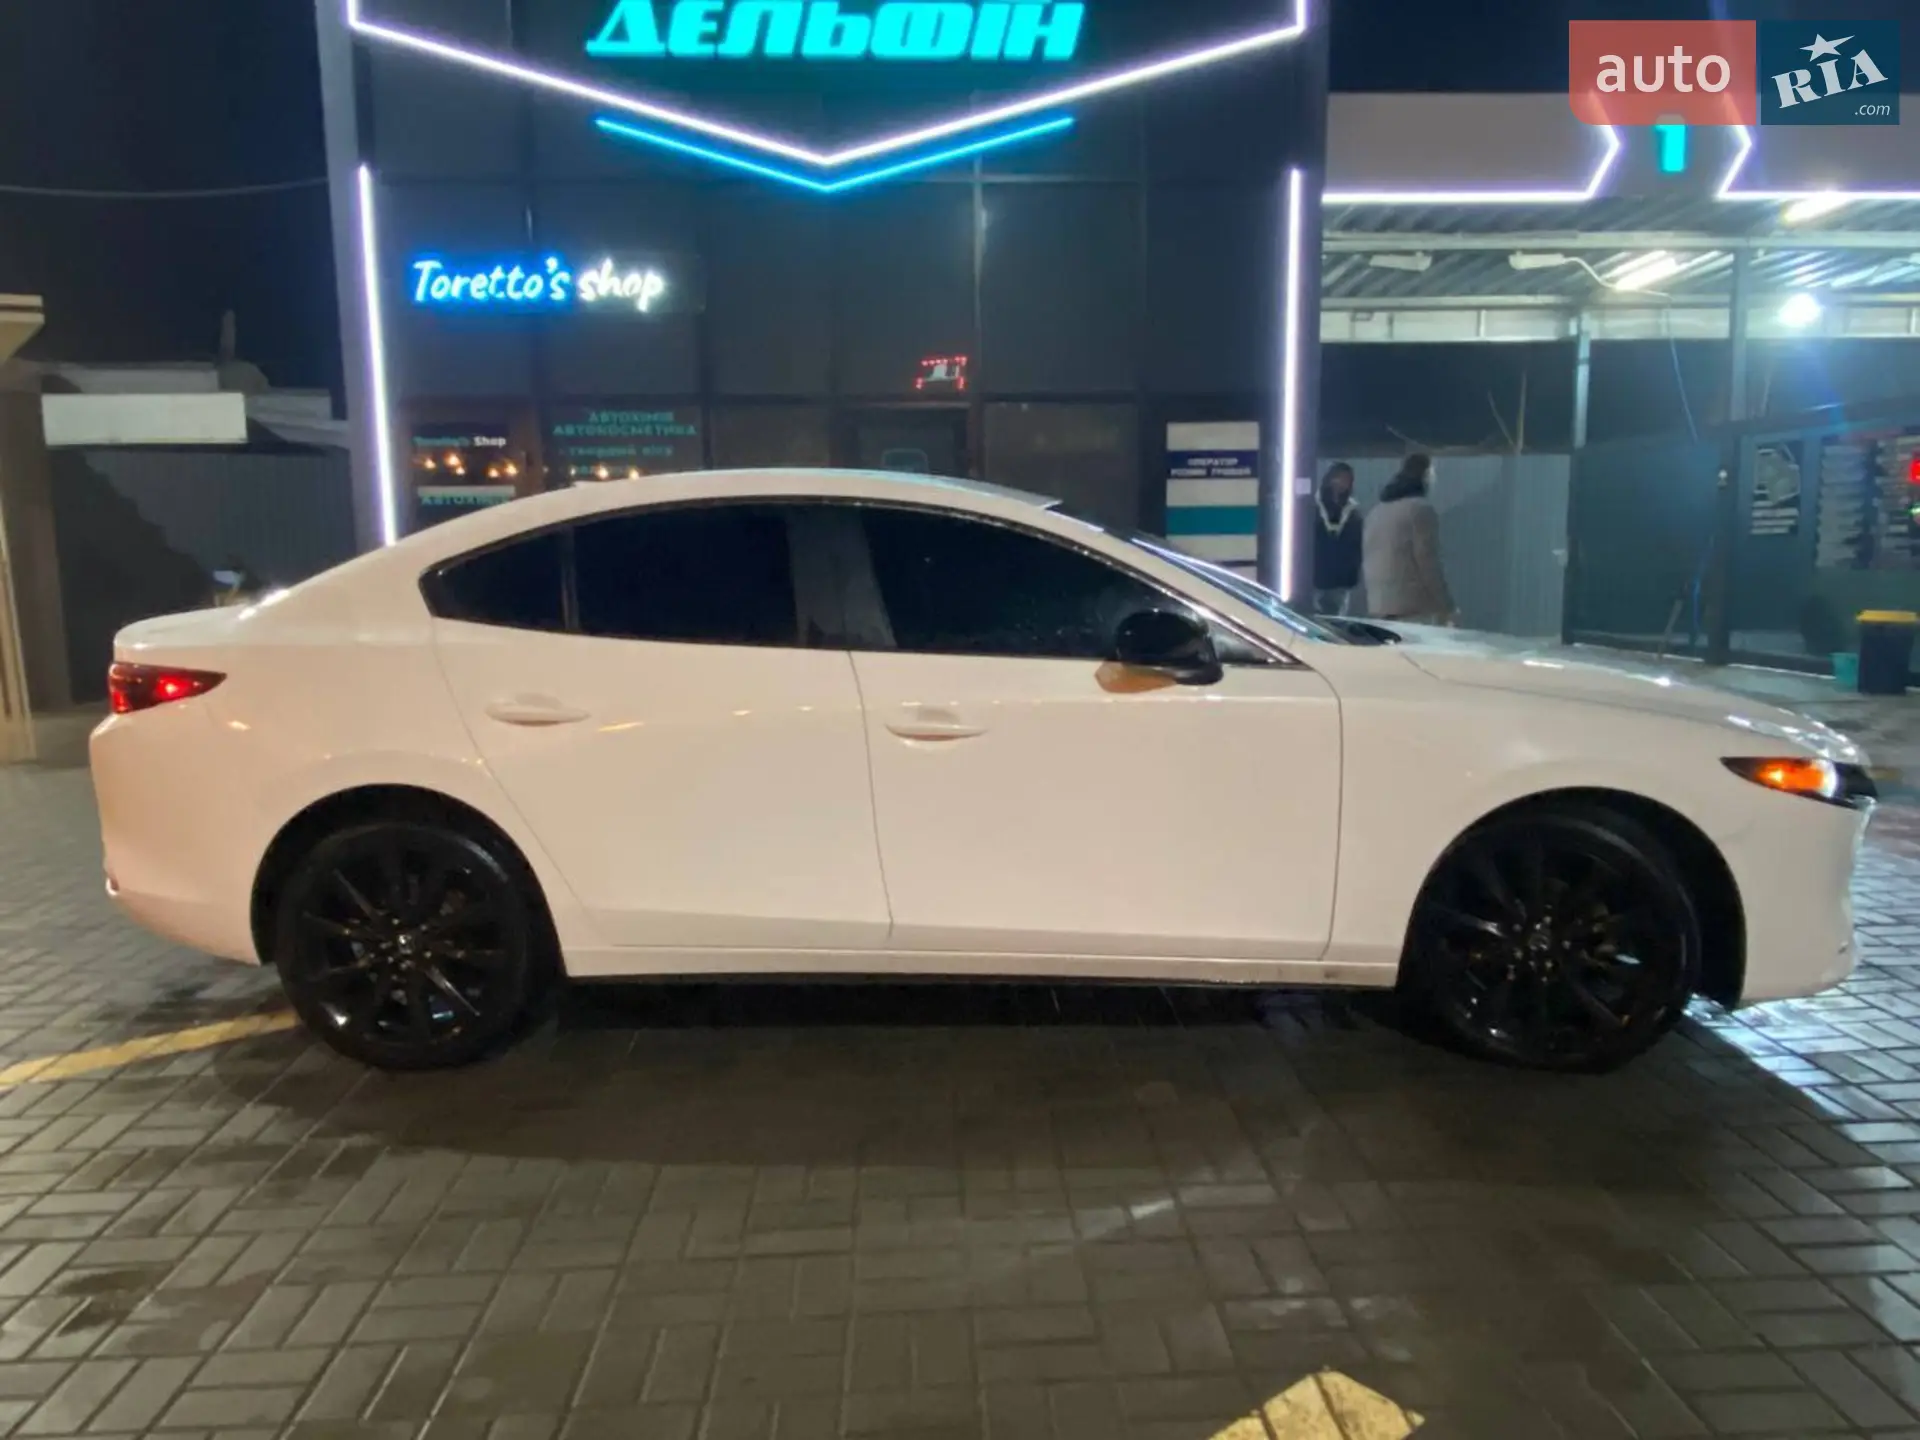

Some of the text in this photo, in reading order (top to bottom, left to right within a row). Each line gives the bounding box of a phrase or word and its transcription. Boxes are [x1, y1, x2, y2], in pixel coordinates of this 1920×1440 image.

[586, 0, 1085, 60] ДЕЛЬФІН
[1655, 114, 1686, 172] 1
[413, 256, 665, 312] Toretto's shop
